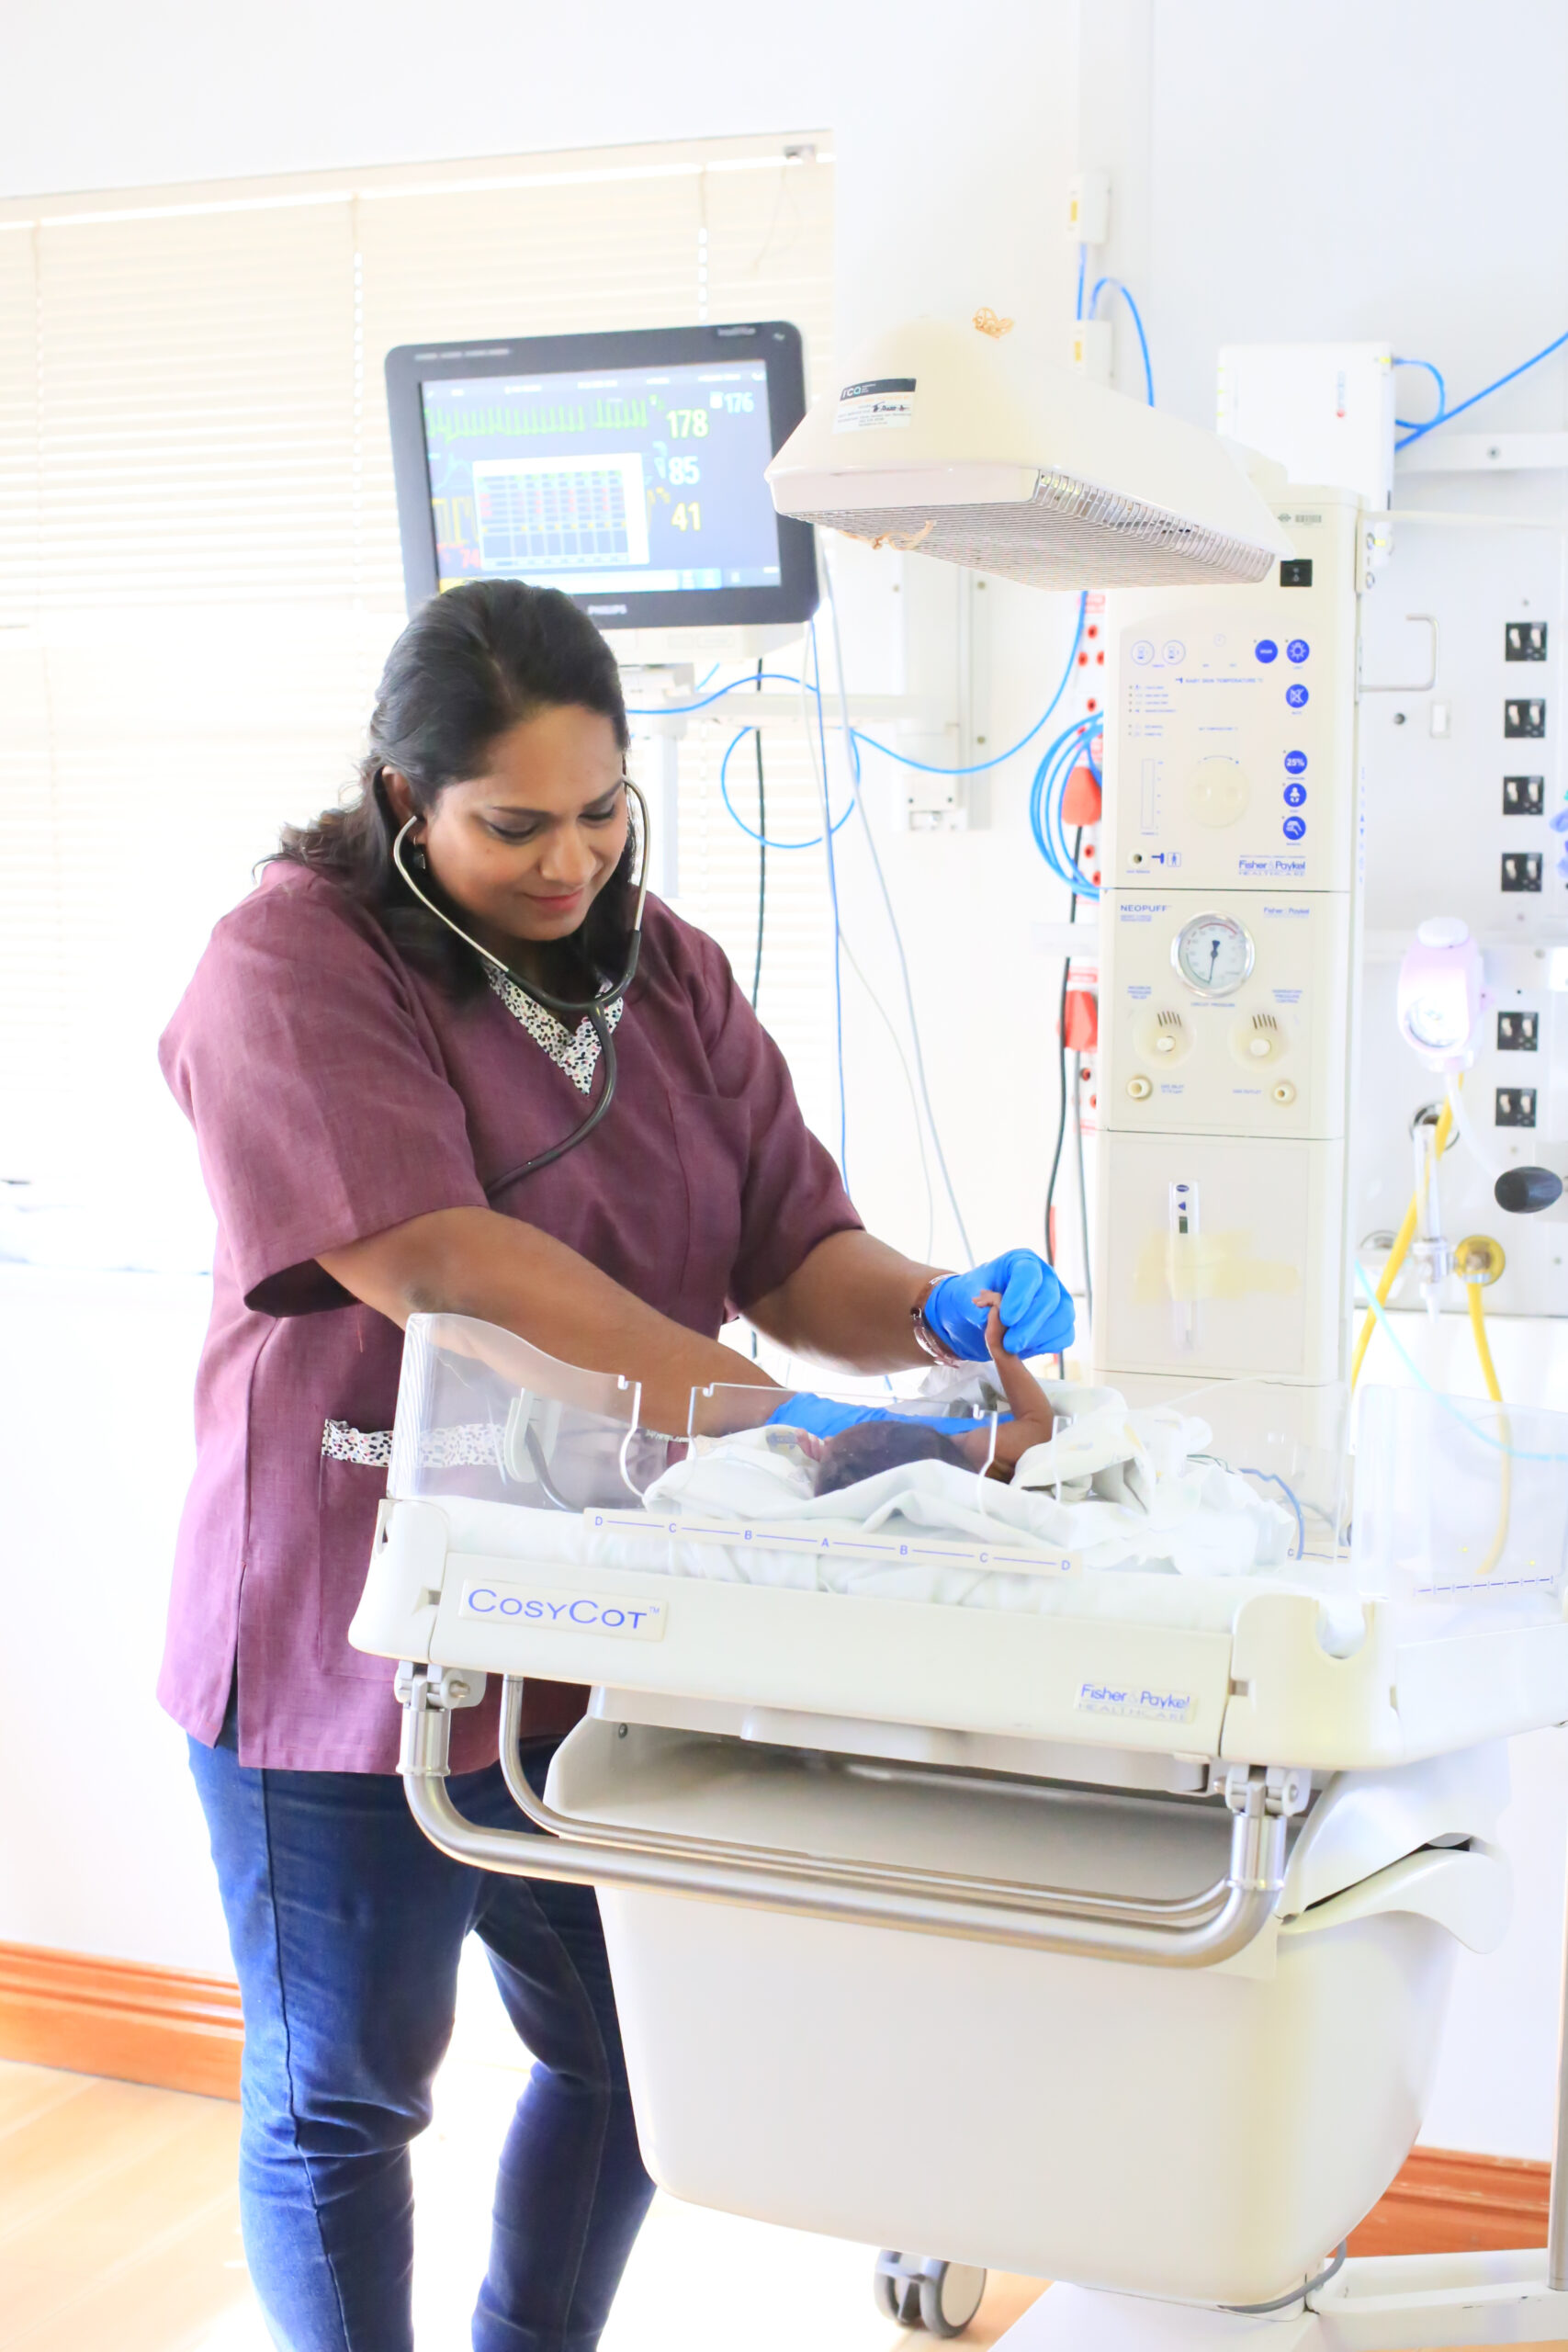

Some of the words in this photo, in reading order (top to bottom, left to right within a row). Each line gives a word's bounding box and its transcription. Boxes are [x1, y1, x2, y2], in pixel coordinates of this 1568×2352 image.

[724, 391, 755, 413] 176
[666, 408, 709, 439] 178
[668, 456, 701, 485] 85
[671, 502, 701, 532] 41
[1286, 758, 1304, 766] 25%
[1238, 859, 1268, 869] Fisher
[1275, 860, 1306, 871] Paykel
[594, 1515, 604, 1527] D
[668, 1521, 677, 1534] C
[743, 1529, 753, 1541] B
[820, 1537, 831, 1549] A
[898, 1544, 909, 1556] B
[979, 1553, 988, 1563] C
[1061, 1560, 1072, 1572] D
[1081, 1683, 1128, 1702] Fisher
[1140, 1690, 1190, 1710] Paykel
